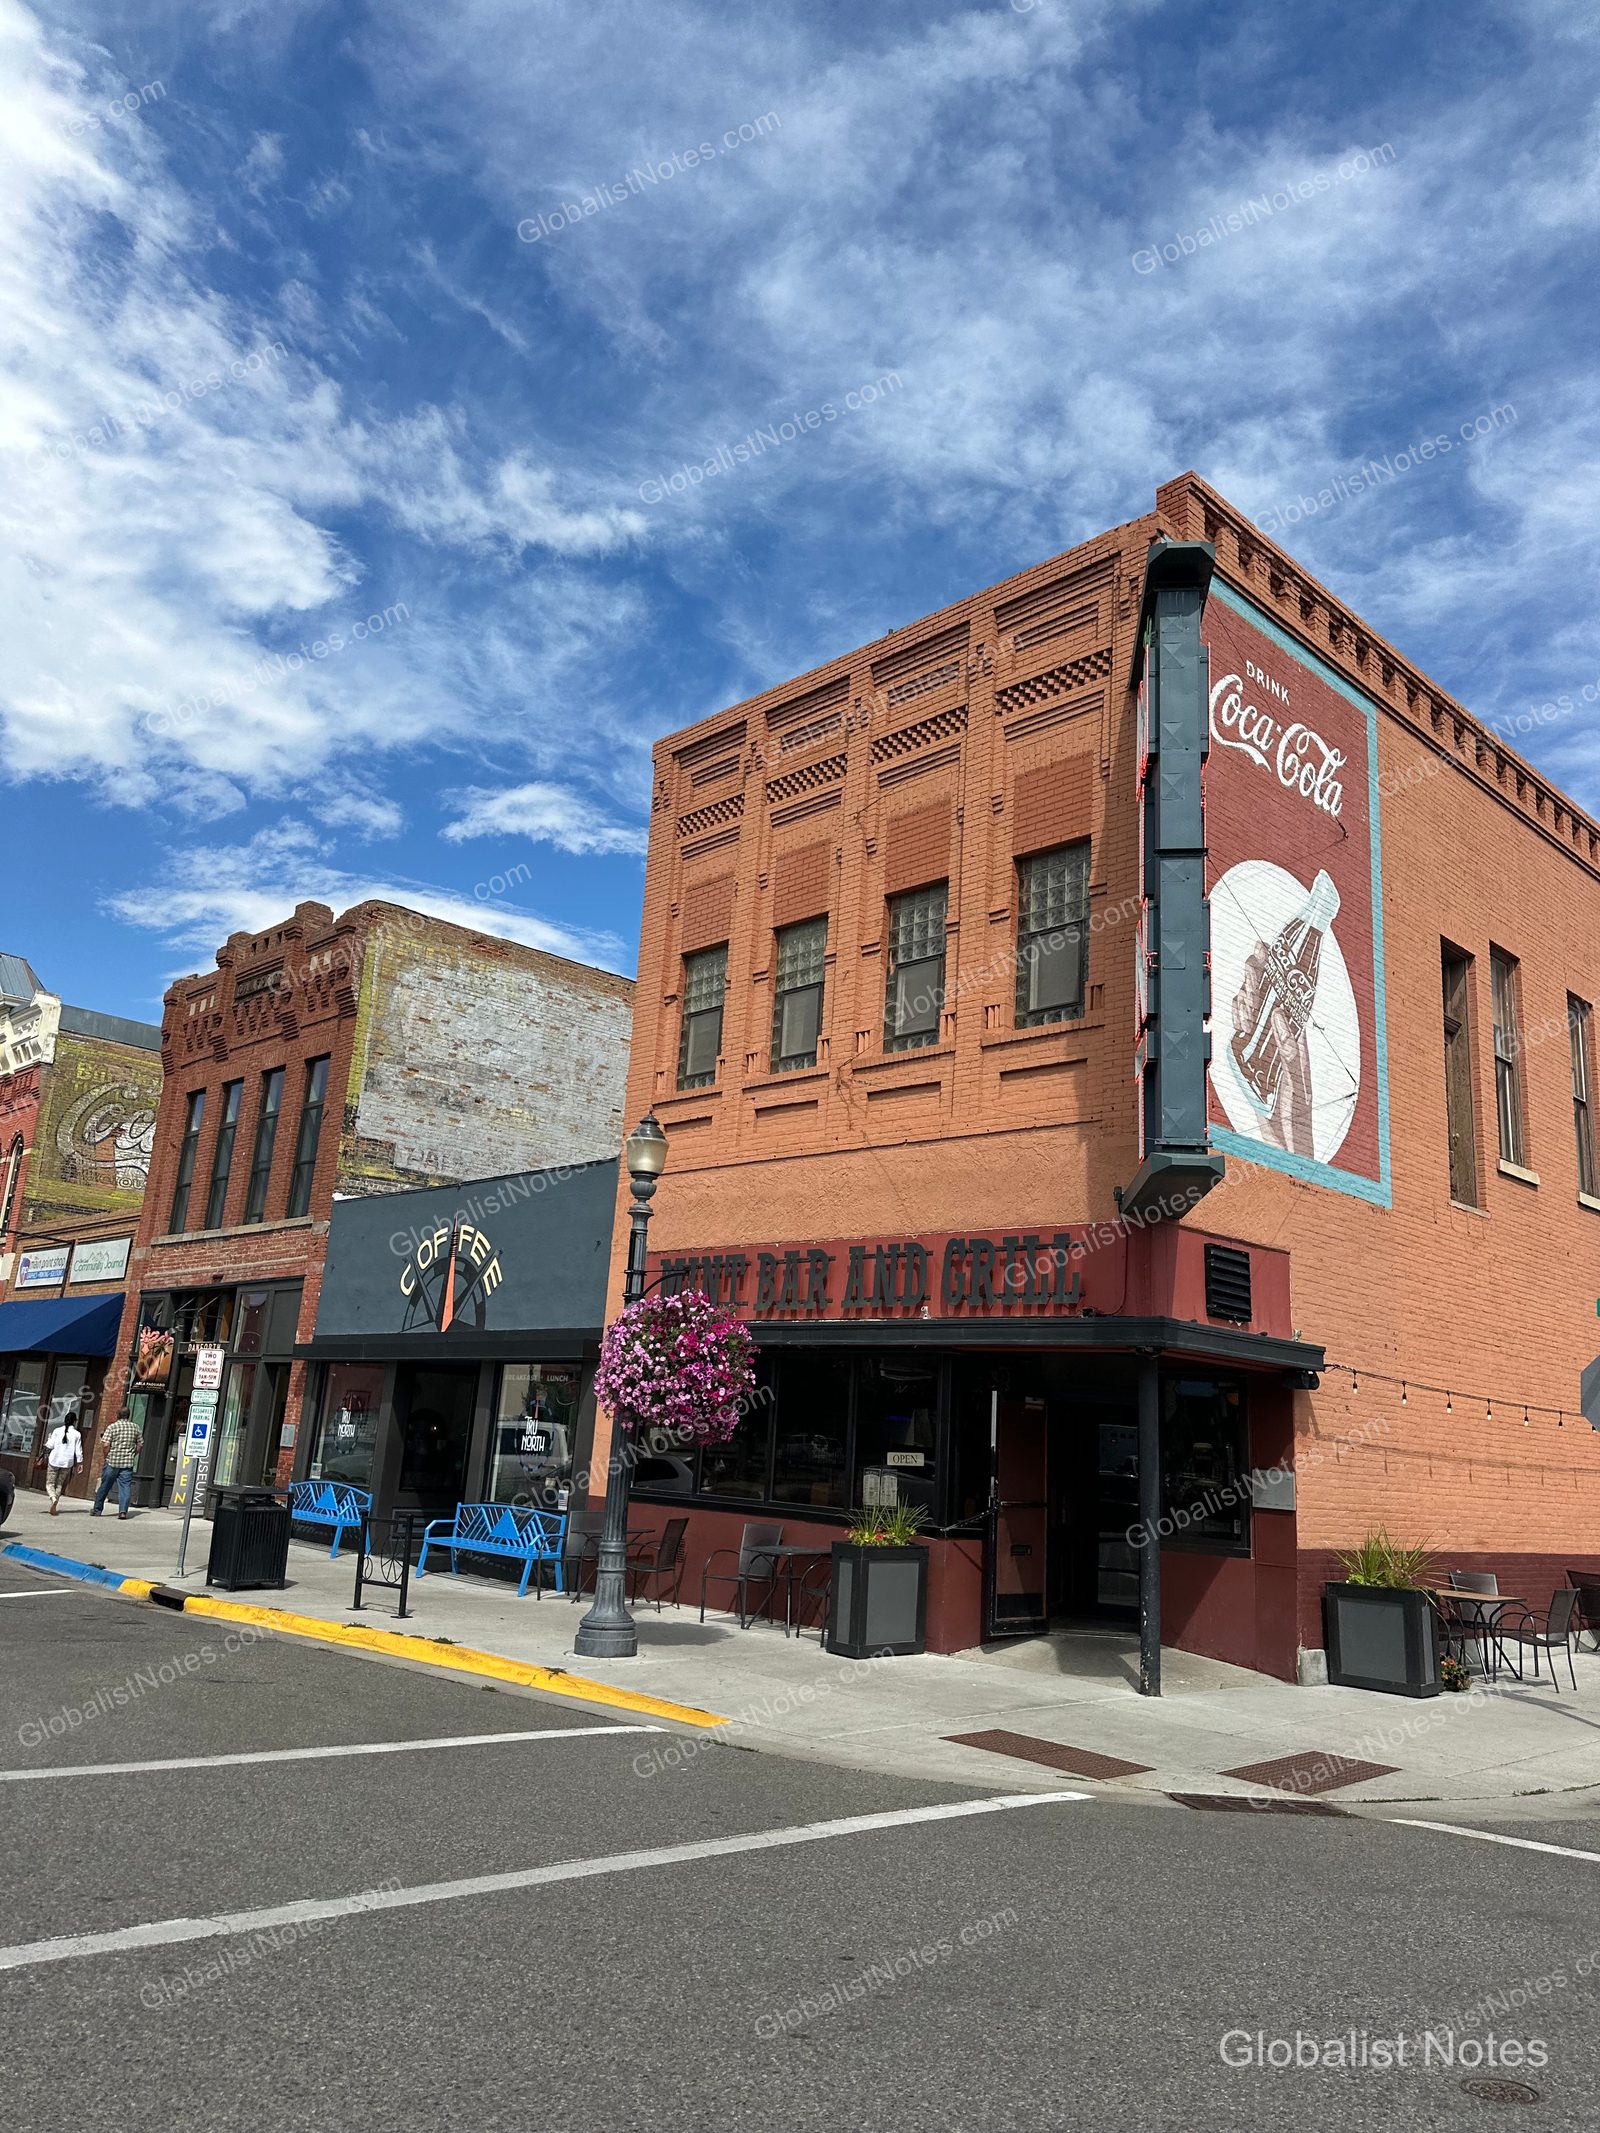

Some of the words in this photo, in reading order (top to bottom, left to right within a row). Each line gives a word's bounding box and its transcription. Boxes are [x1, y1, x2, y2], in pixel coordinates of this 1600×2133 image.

[1246, 660, 1290, 706] DRINK
[74, 1260, 103, 1273] Community
[103, 1256, 126, 1269] Journal
[400, 1224, 503, 1297] COFFEE
[660, 1253, 746, 1305] MINT
[753, 1248, 830, 1311] BAR
[842, 1242, 928, 1310] AND
[941, 1233, 1080, 1307] GRILL
[198, 1366, 219, 1374] PARKING
[546, 1374, 569, 1382] LUNCH
[341, 1407, 352, 1424] TRU
[337, 1423, 356, 1438] NORTH
[525, 1415, 539, 1436] TRU
[521, 1435, 546, 1452] NORTH
[892, 1454, 919, 1465] OPEN
[192, 1454, 211, 1506] USEUM
